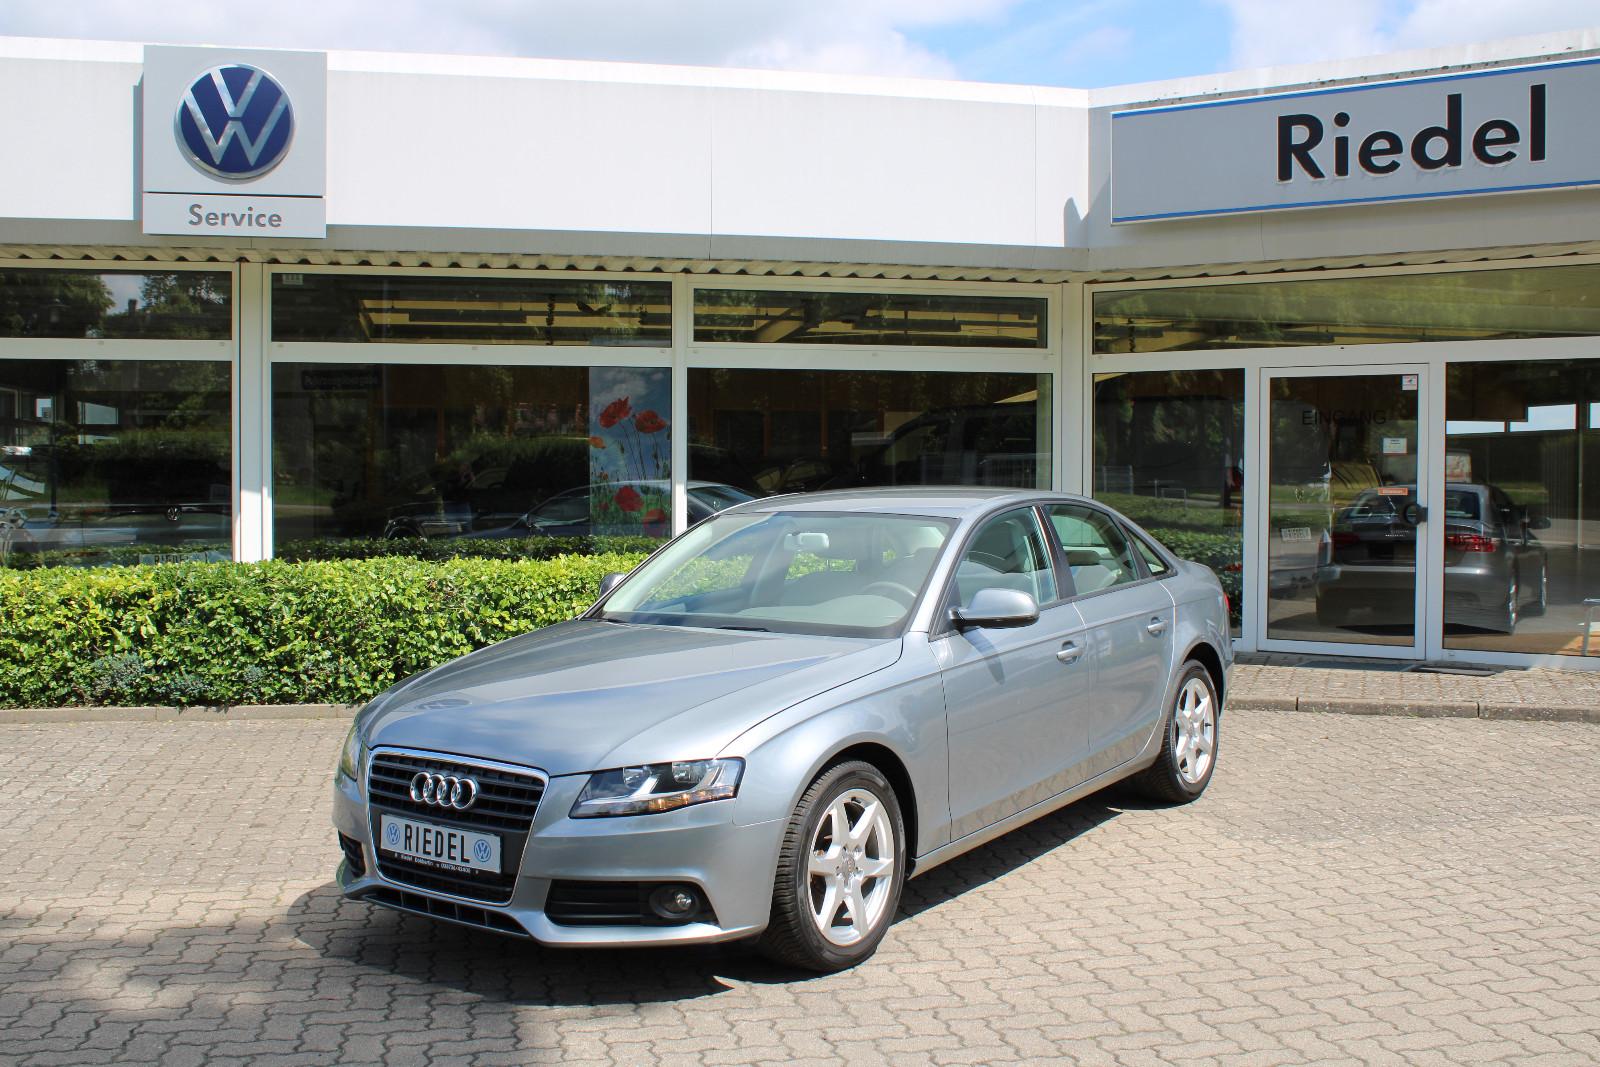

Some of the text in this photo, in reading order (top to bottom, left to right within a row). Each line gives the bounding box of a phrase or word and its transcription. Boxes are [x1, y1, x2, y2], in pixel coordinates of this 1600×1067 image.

[1277, 83, 1547, 183] Riedel
[188, 204, 283, 229] Service
[1302, 409, 1386, 426] EINGANG
[404, 824, 470, 863] RIEDEL
